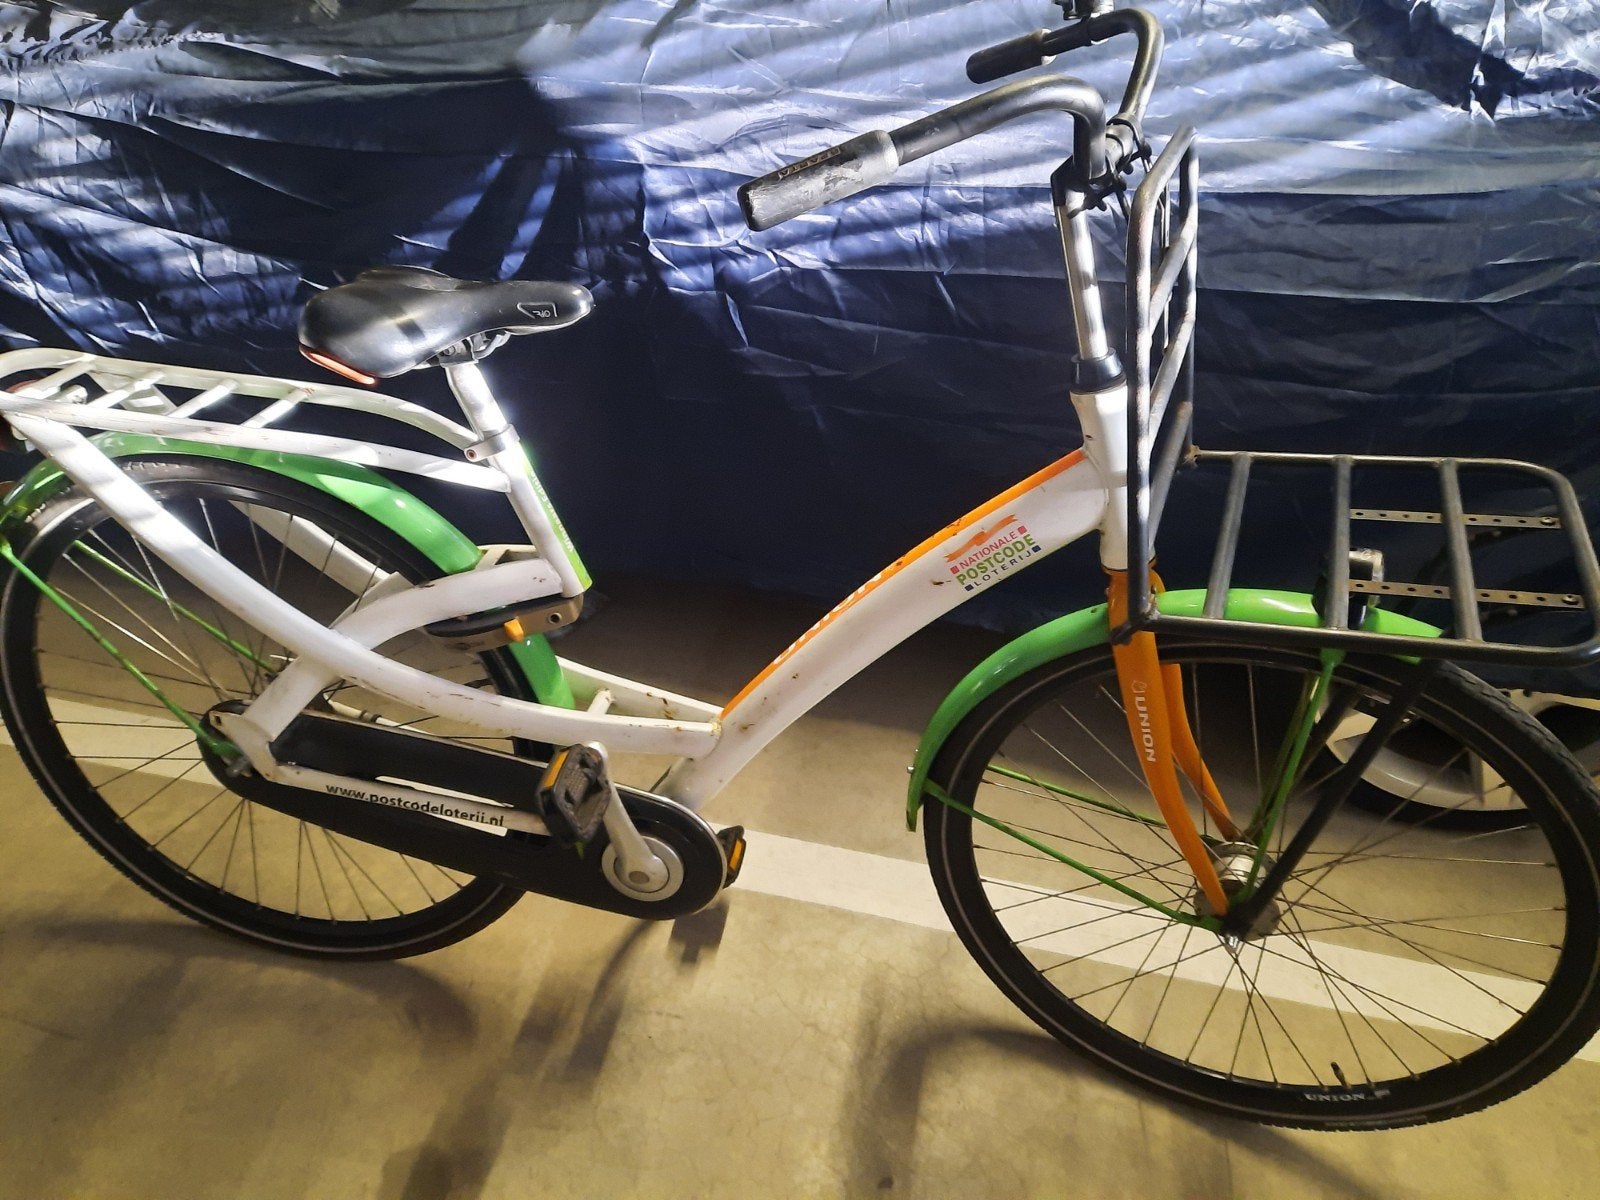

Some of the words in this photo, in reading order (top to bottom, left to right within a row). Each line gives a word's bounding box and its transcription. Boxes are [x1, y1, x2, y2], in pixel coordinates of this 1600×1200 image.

[956, 534, 1036, 585] POSTCODE
[959, 531, 1018, 569] NATIONALE
[974, 551, 1031, 587] LOTERIJ
[1135, 696, 1156, 762] UNION
[1304, 1093, 1366, 1101] UNION
